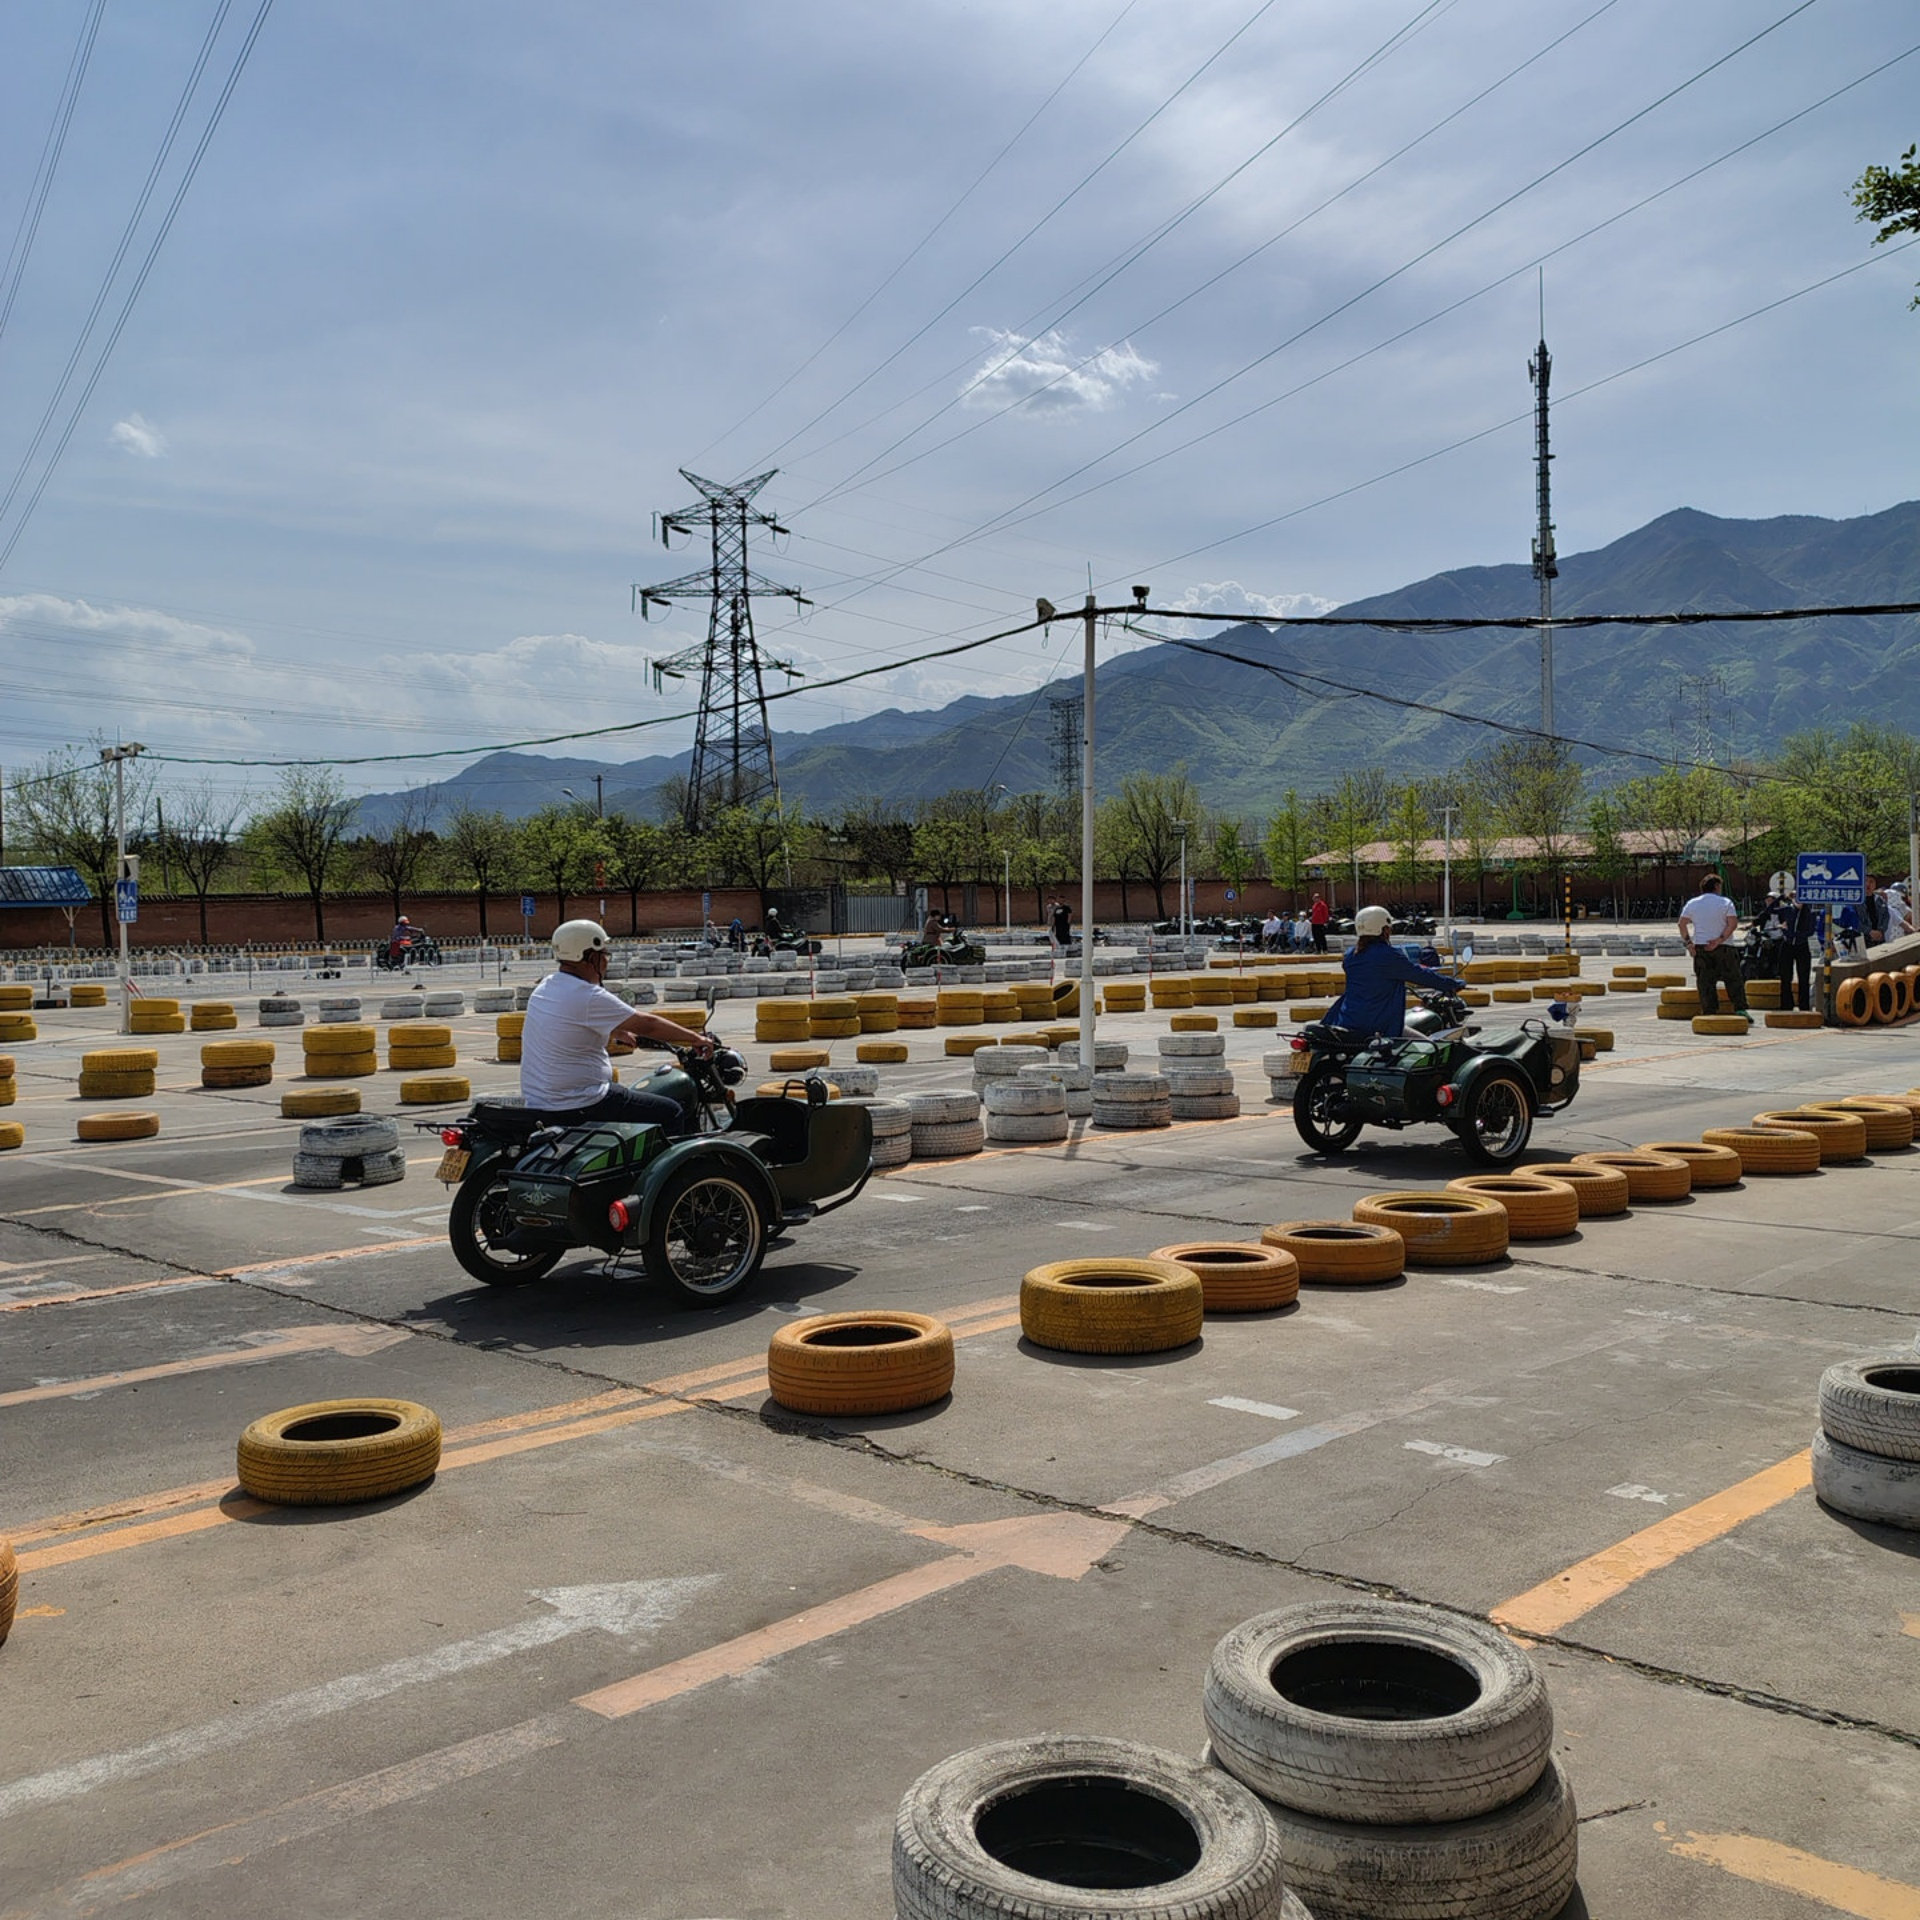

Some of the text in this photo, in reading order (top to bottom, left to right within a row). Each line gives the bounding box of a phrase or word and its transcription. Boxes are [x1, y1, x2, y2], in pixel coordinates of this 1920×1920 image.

[1799, 888, 1860, 901] 上坡定点停车与起步
